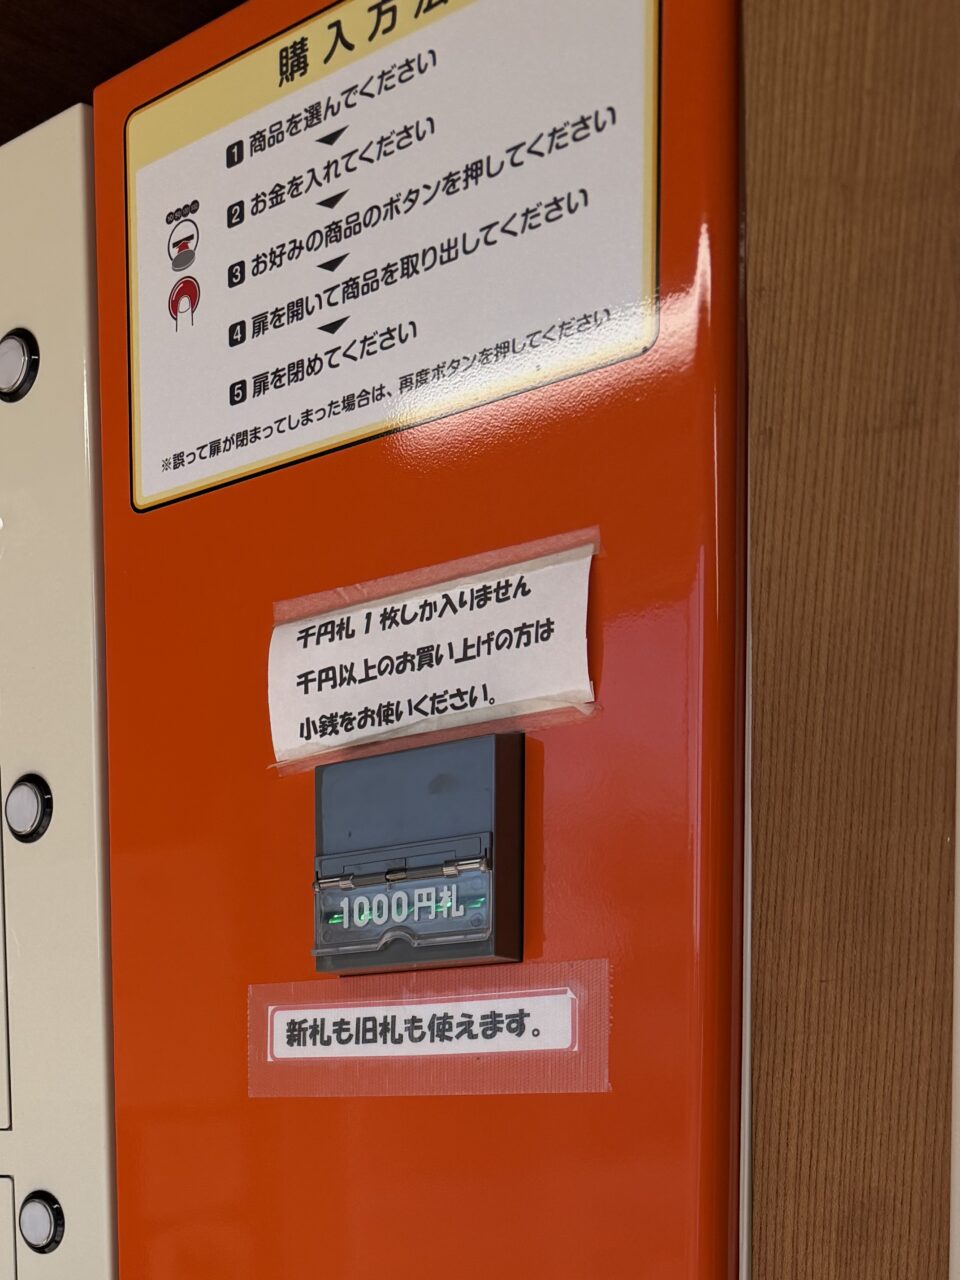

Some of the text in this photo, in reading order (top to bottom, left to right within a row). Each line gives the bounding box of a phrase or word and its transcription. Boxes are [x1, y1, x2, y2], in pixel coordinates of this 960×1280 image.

[248, 49, 437, 156] 商品を選んでください
[250, 116, 435, 216] お金を入れてください
[250, 106, 617, 278] お好みの商品のボタンを押してください
[251, 188, 589, 338] 扉を開いて商品を取り出してください
[251, 320, 418, 398] 扉を閉めてください
[296, 618, 555, 695] 千円以上のお買い上げの方は
[298, 683, 496, 741] 小銭をお使いください。
[339, 884, 464, 930] 1000円札
[285, 1009, 541, 1047] 新札も旧札も使えます。
